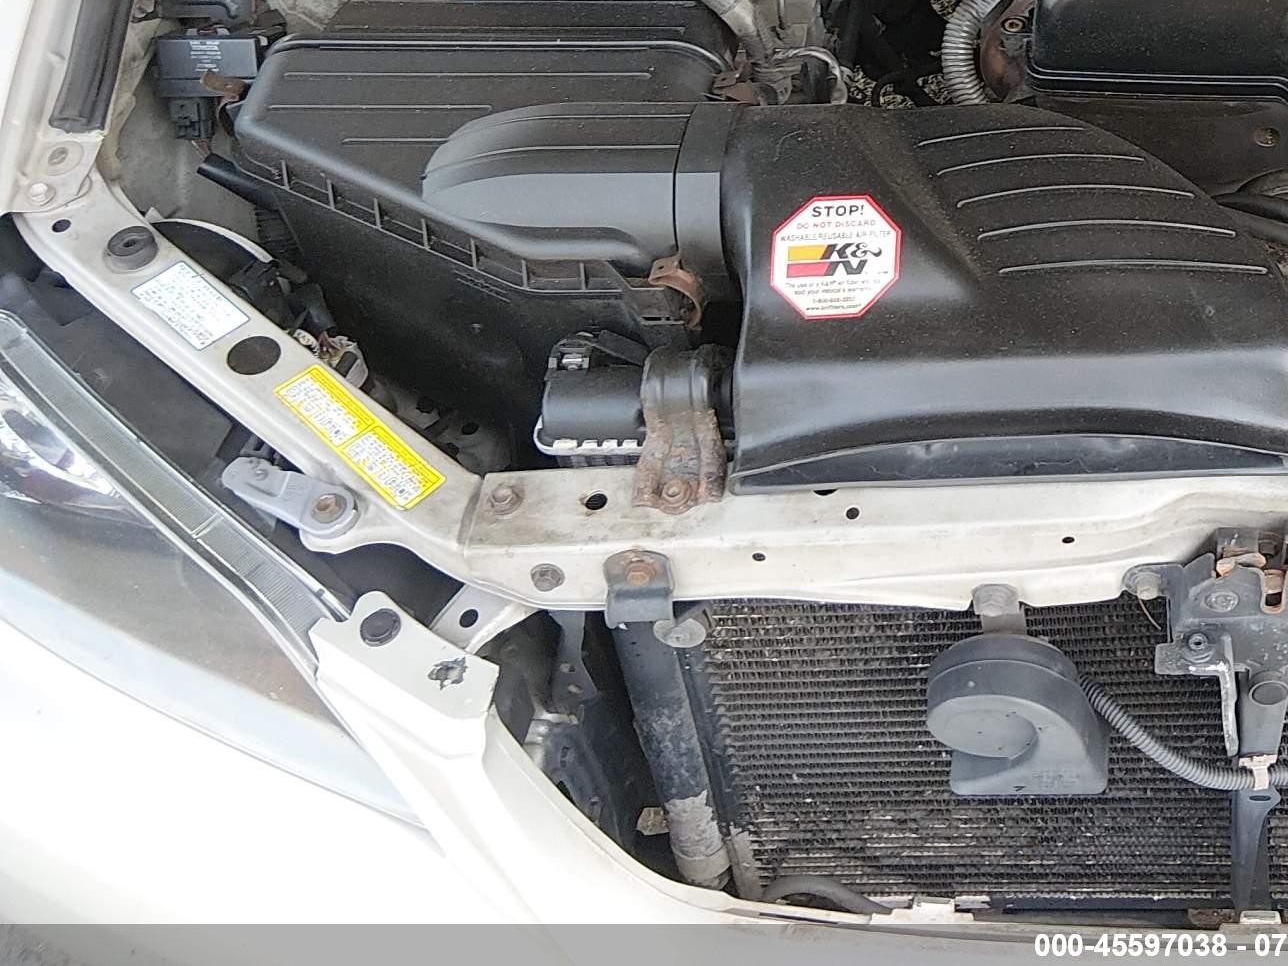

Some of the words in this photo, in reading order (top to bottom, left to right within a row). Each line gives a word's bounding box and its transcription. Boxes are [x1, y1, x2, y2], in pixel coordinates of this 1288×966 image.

[811, 204, 865, 218] STOP!
[797, 222, 810, 230] DO
[812, 221, 832, 229] NOT
[835, 219, 876, 228] DISCARD
